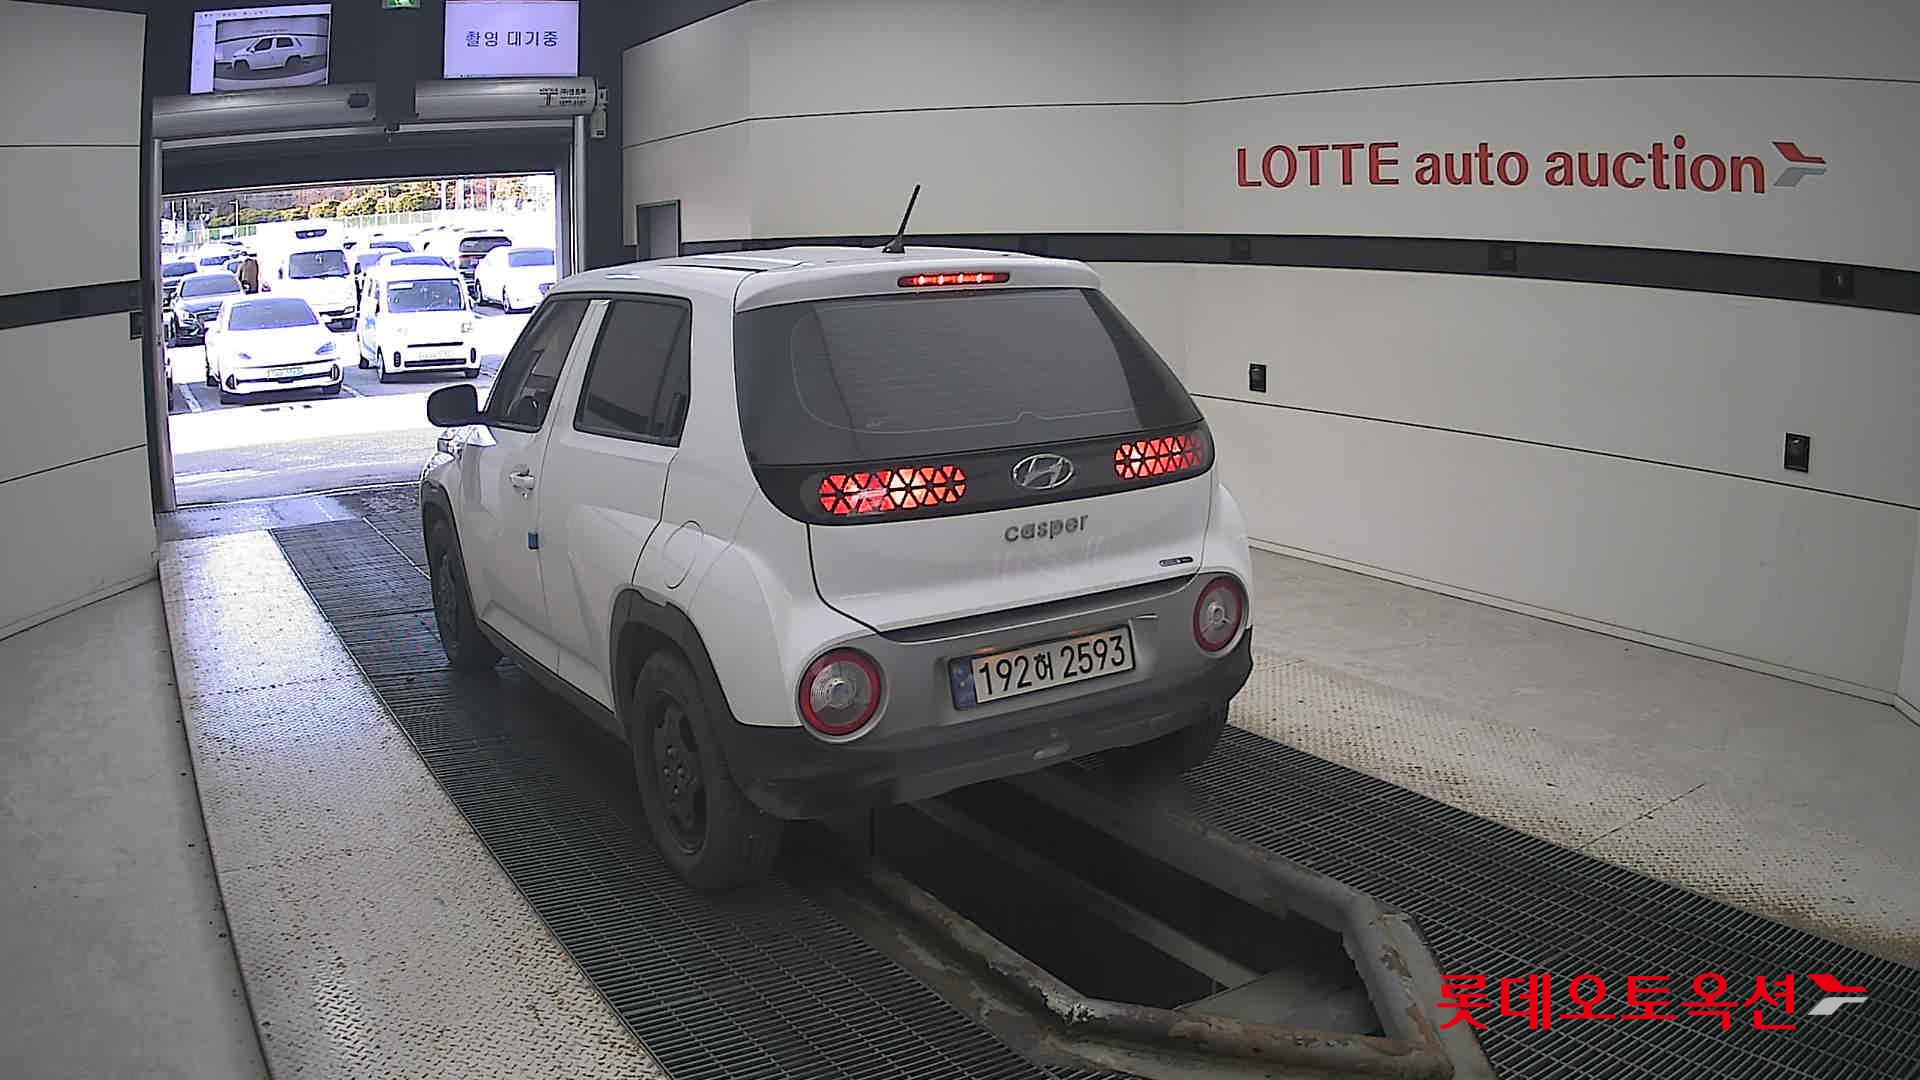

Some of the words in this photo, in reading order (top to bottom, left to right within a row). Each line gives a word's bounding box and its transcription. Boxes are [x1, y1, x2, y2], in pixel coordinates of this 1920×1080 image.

[506, 30, 560, 48] 대기중
[1236, 141, 1400, 189] LOTTE
[1414, 142, 1530, 187] auto
[1544, 134, 1767, 194] auction
[1004, 514, 1089, 542] casper
[978, 652, 1053, 695] 192허
[1060, 635, 1125, 679] 2593
